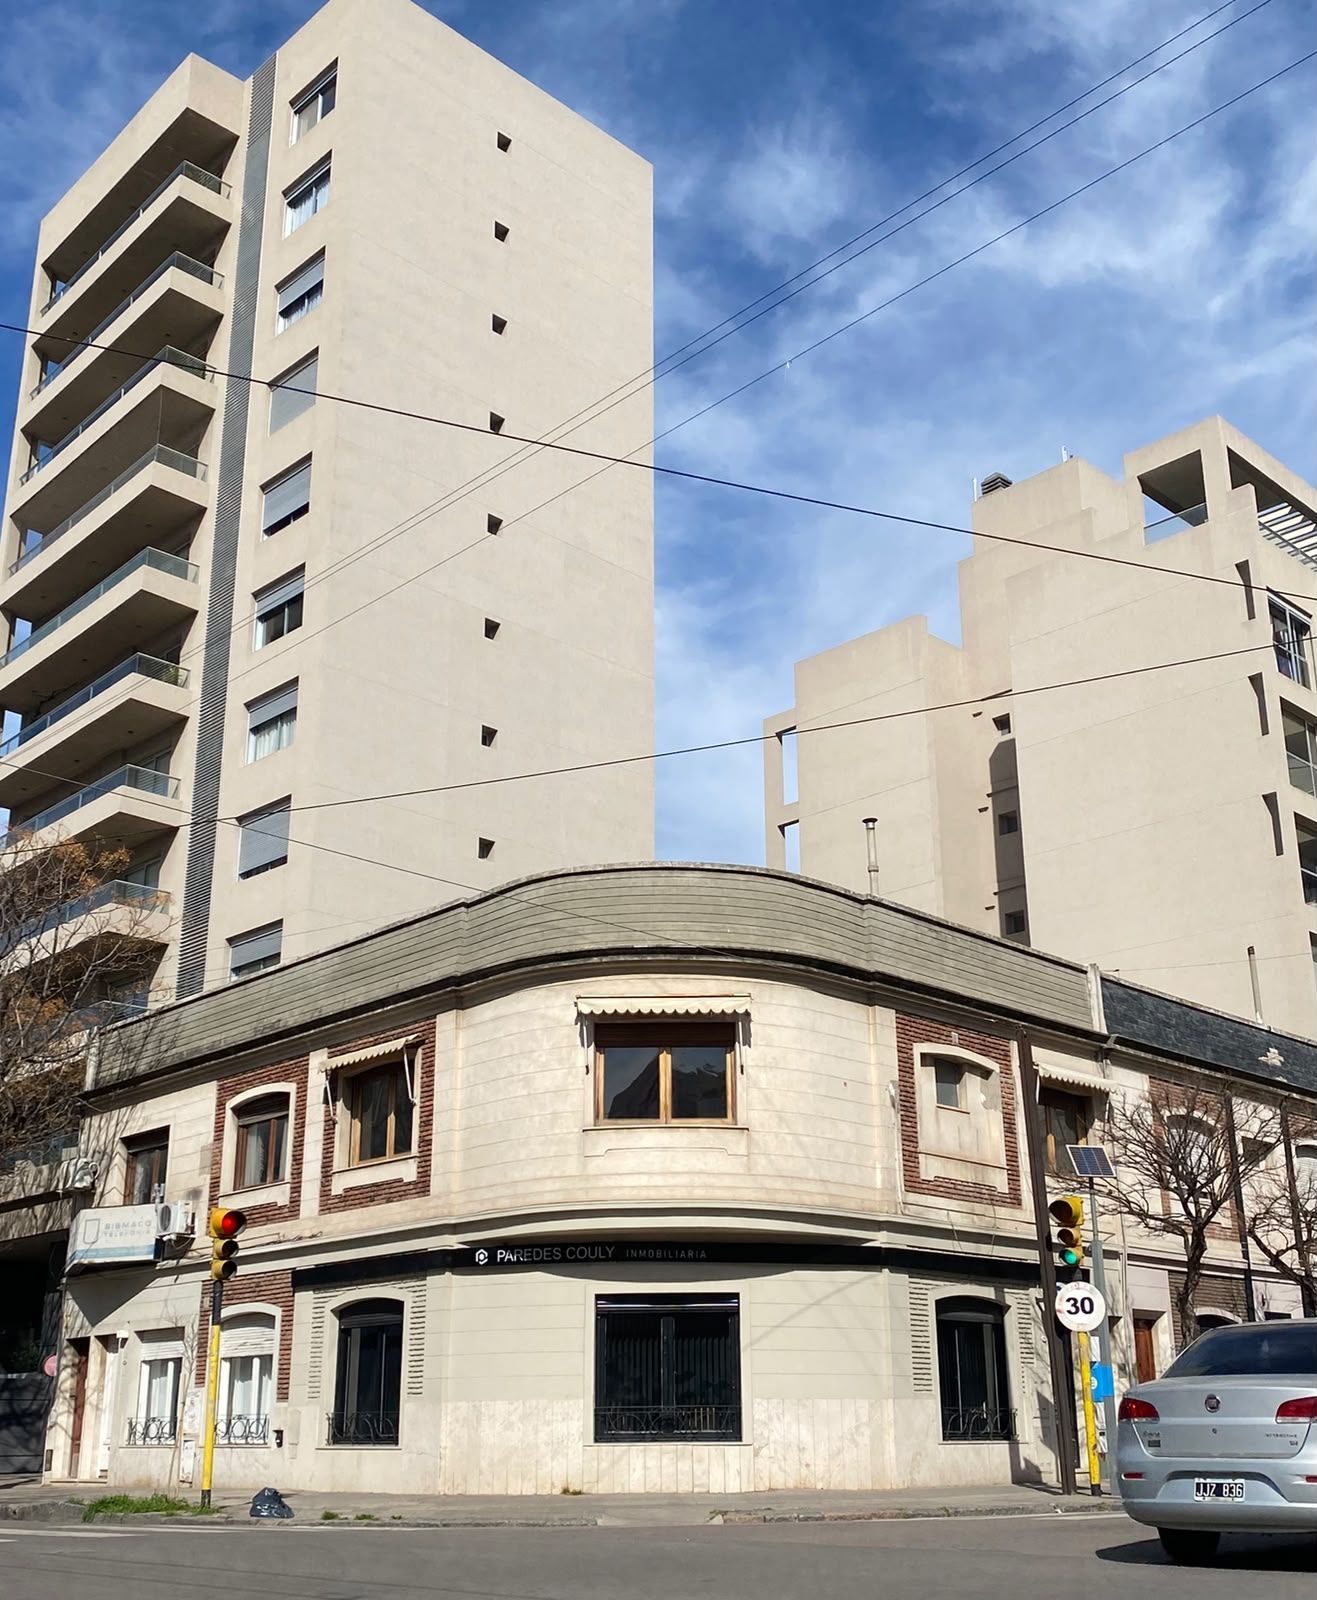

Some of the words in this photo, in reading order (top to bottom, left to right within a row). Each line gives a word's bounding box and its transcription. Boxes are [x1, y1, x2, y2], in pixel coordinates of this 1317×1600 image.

[496, 1247, 562, 1263] PAREDES
[566, 1246, 615, 1260] COULY
[626, 1248, 707, 1259] INMOBILIARIA
[1065, 1296, 1095, 1316] 30
[1196, 1483, 1217, 1497] JJZ
[1222, 1483, 1244, 1497] 836
